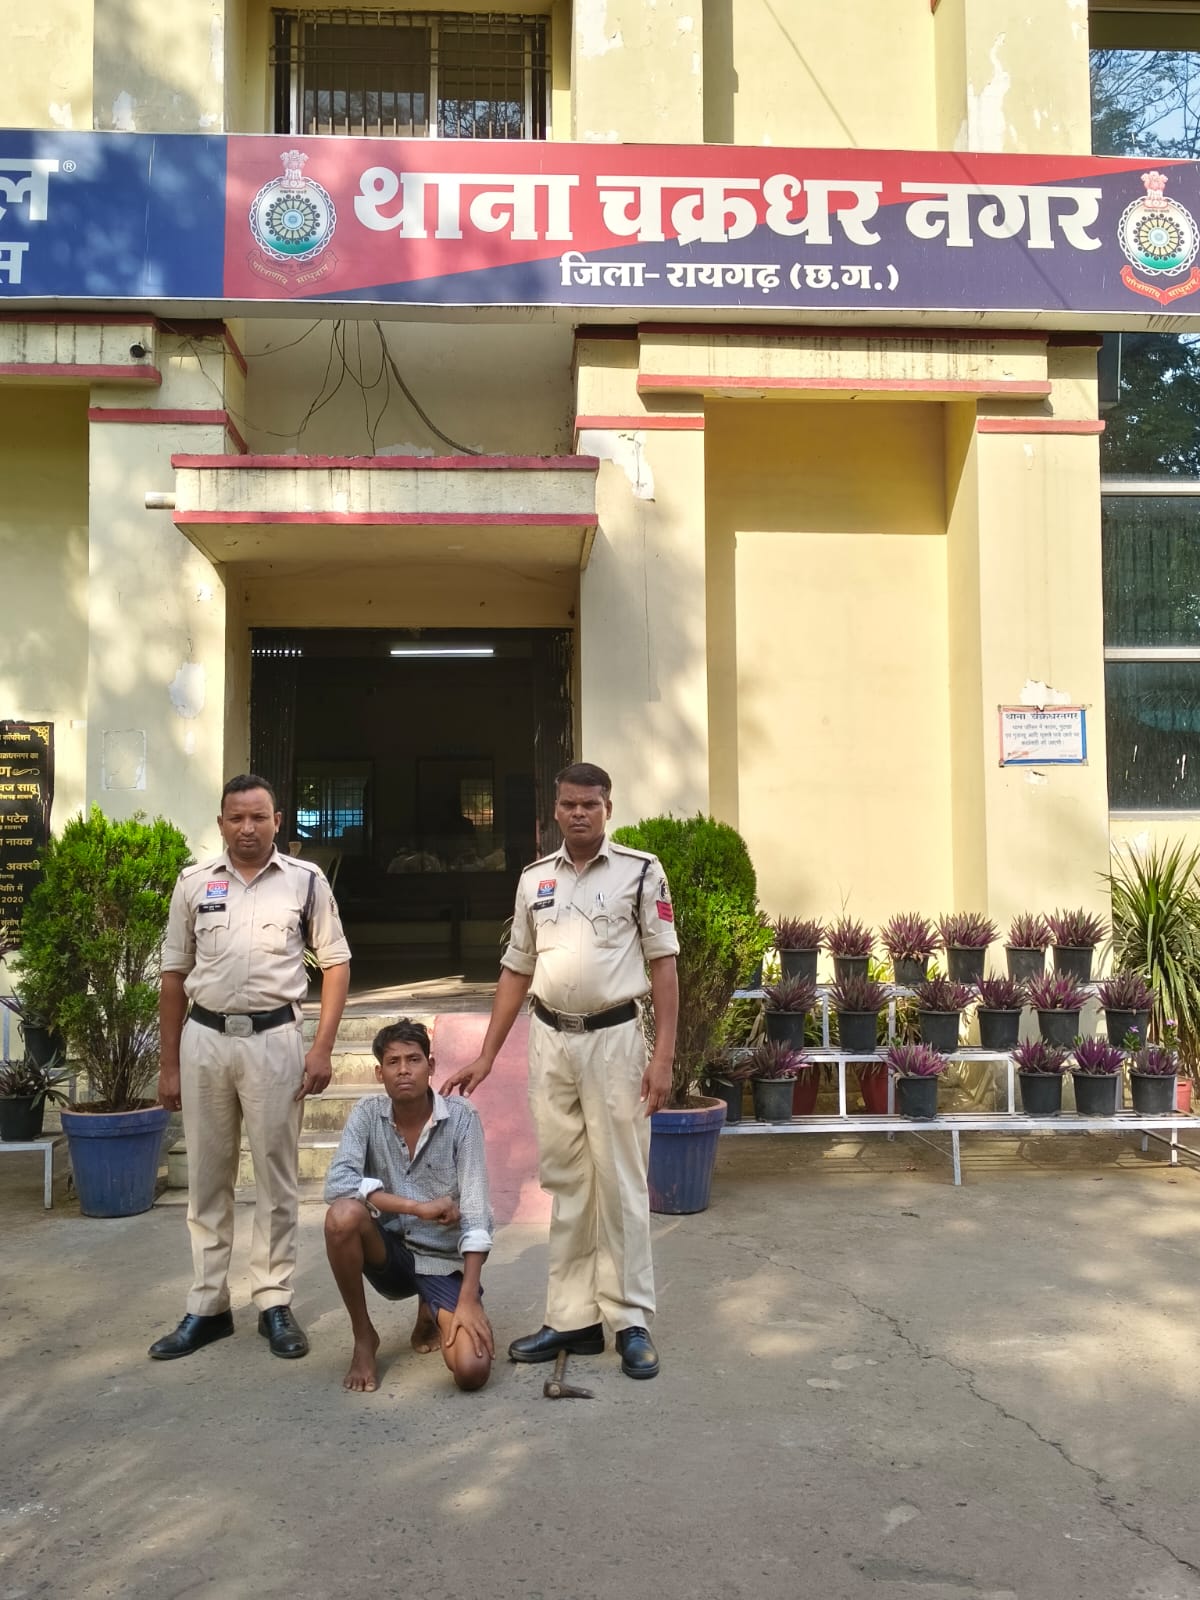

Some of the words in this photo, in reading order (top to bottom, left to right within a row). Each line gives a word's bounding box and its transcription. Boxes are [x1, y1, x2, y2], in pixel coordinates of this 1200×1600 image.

[354, 166, 580, 240] थाना
[596, 173, 883, 246] चक्रधर
[901, 181, 1103, 250] नगर
[666, 263, 781, 293] रायगढ़
[789, 263, 900, 291] (छ.ग.)
[1005, 713, 1027, 721] थाना
[16, 783, 38, 795] साहू
[7, 812, 29, 823] पटेल
[5, 838, 33, 846] नायक
